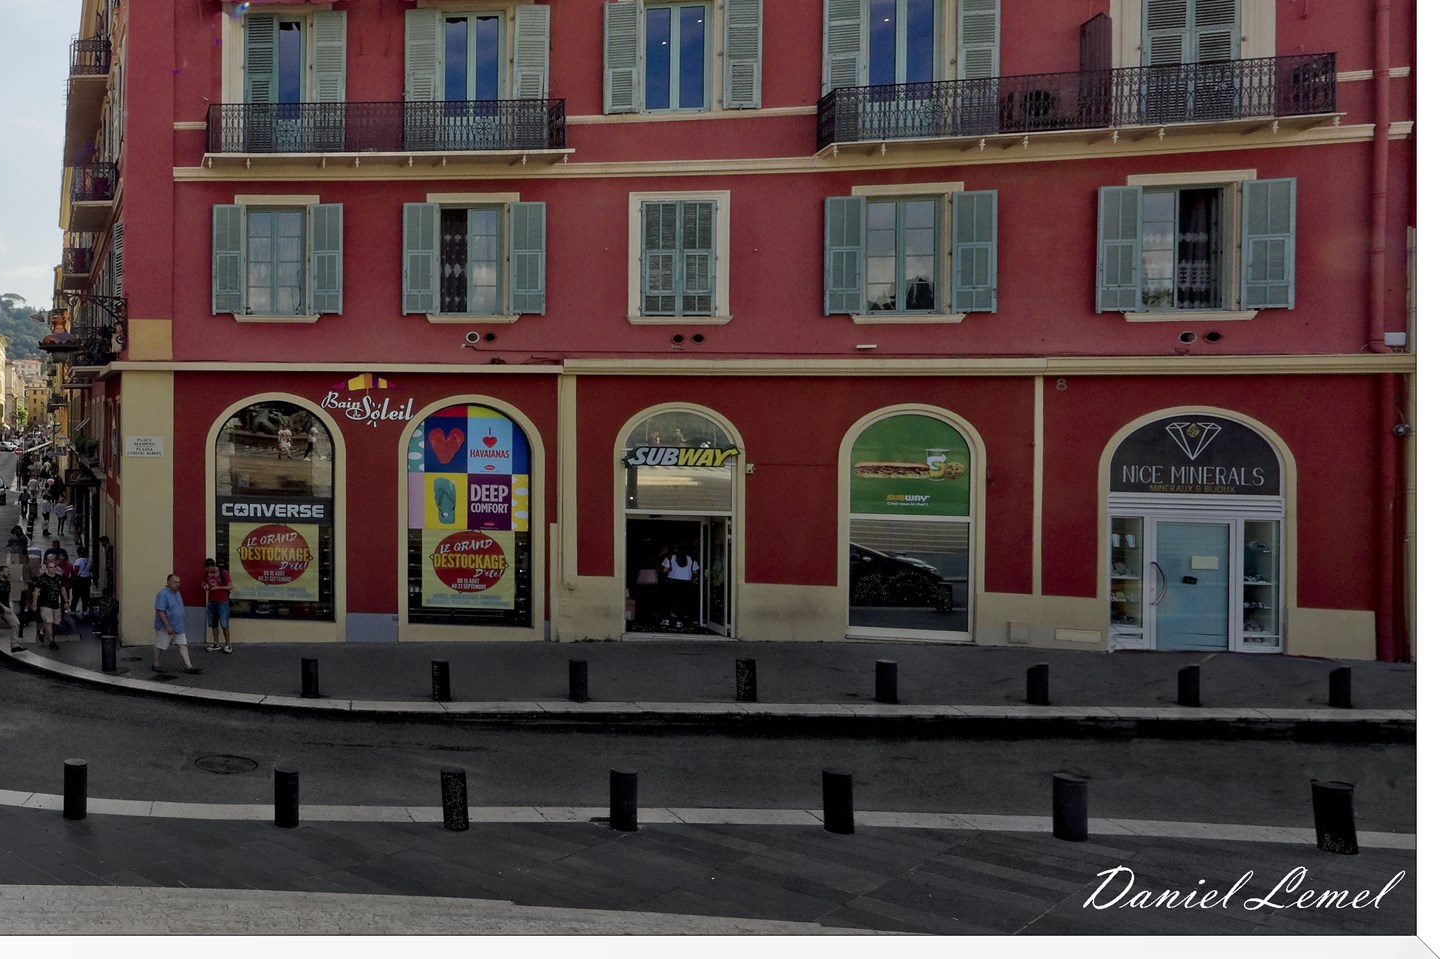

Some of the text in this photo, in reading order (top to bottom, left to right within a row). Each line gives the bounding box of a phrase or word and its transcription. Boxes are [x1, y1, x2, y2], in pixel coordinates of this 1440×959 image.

[1056, 378, 1067, 390] 8
[321, 391, 362, 409] Bain
[345, 395, 414, 420] Soleil
[488, 427, 492, 435] I
[469, 449, 510, 459] HAVAIANAS
[627, 447, 739, 466] SUBWAY
[1122, 465, 1265, 486] NICE MINERALS
[470, 484, 509, 502] DEEP
[1204, 485, 1236, 493] BIJOUX
[221, 503, 324, 518] CONVERSE
[470, 503, 509, 514] COMFORT
[246, 532, 298, 547] LE GRAND
[440, 539, 493, 554] LE GRAND
[240, 546, 310, 561] DESTOCKAGE
[434, 553, 506, 569] DESTOCKAGE
